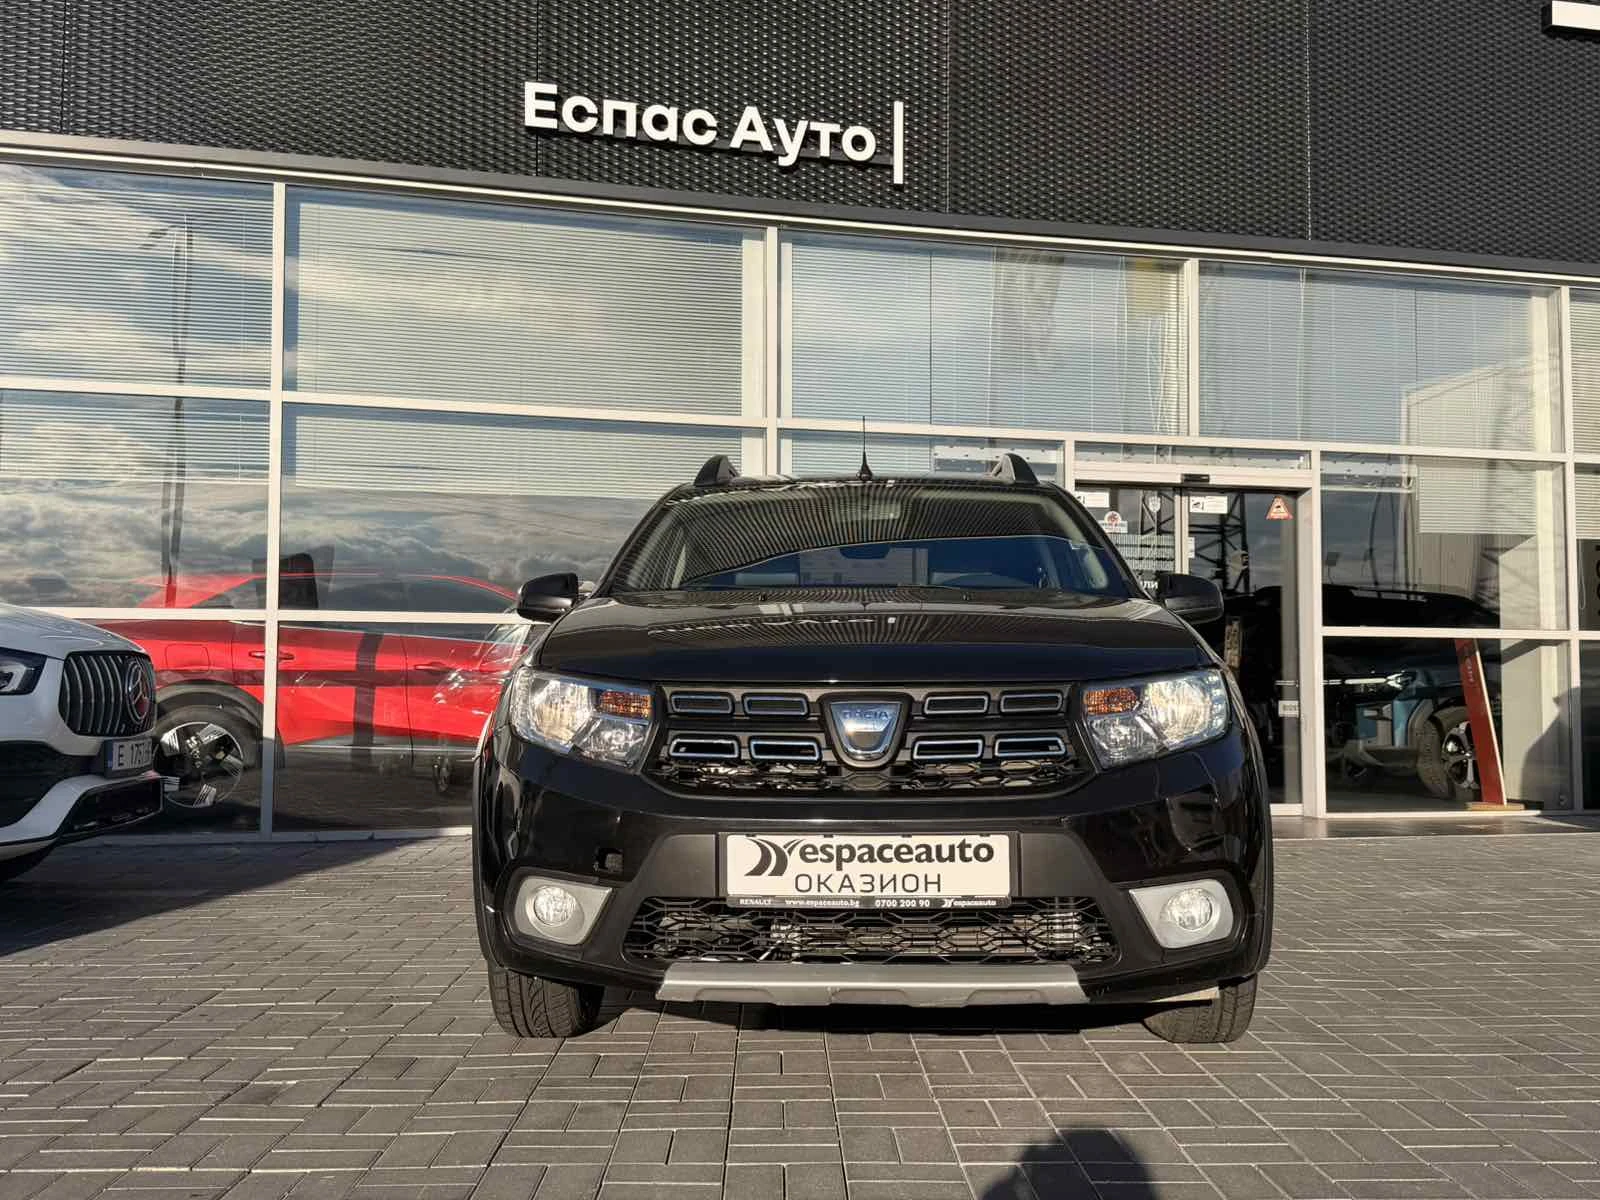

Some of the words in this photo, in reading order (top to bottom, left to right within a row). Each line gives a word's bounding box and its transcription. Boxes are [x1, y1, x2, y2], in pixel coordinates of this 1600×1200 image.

[524, 81, 717, 146] Еспас
[729, 105, 877, 166] Ауто
[799, 838, 995, 871] espaceauto
[794, 873, 942, 893] ОКАЗИОН
[739, 898, 772, 906] RENAULT
[874, 899, 897, 908] 0700
